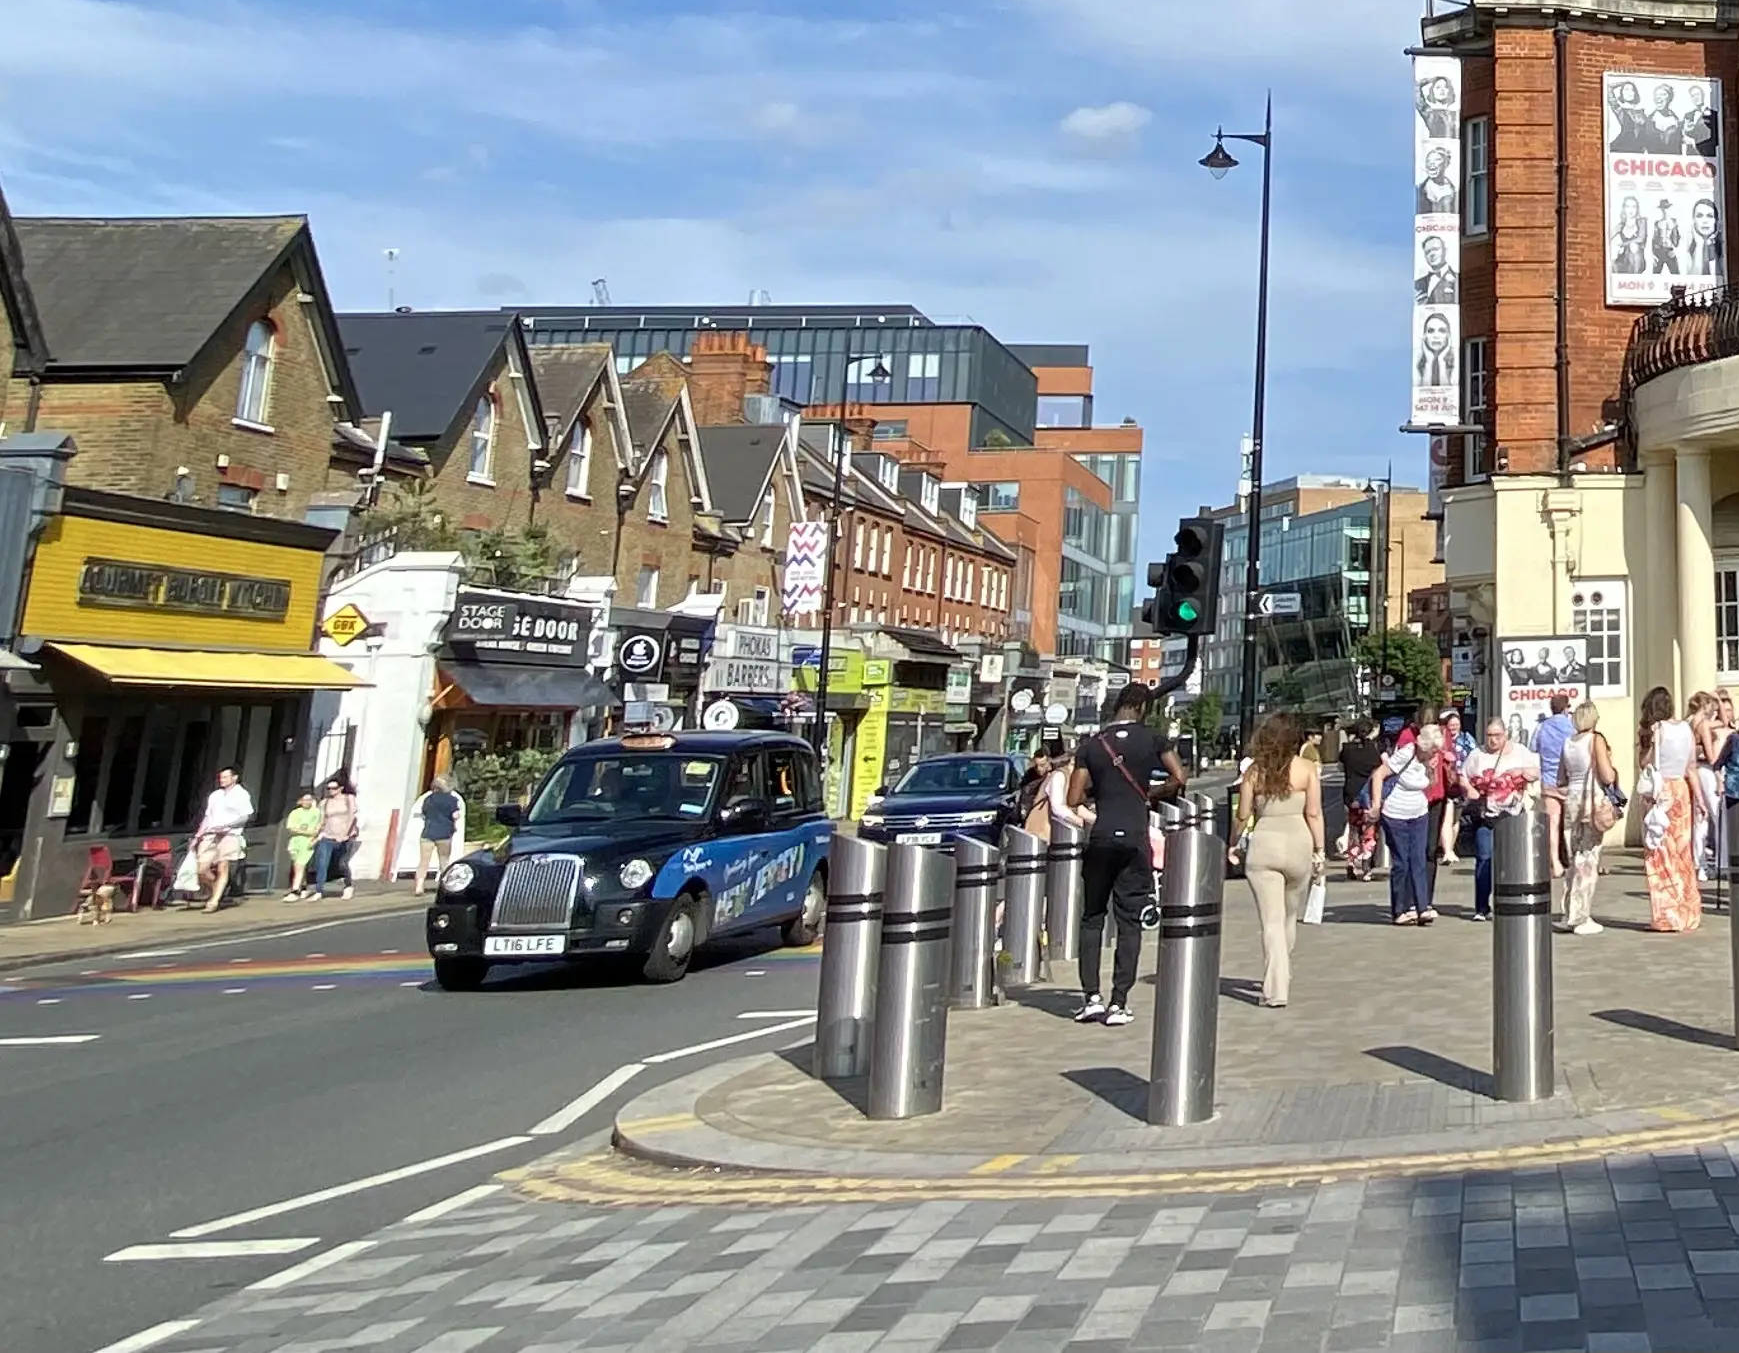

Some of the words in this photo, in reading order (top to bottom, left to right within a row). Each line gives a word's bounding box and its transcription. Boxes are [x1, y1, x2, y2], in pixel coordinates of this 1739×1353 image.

[1613, 158, 1717, 179] CHICAGO
[460, 604, 505, 618] STAGE
[458, 616, 503, 630] DOOR
[533, 618, 579, 641] DOOR
[727, 662, 769, 687] BARBERS
[493, 938, 523, 952] LT16
[526, 937, 555, 951] LFE
